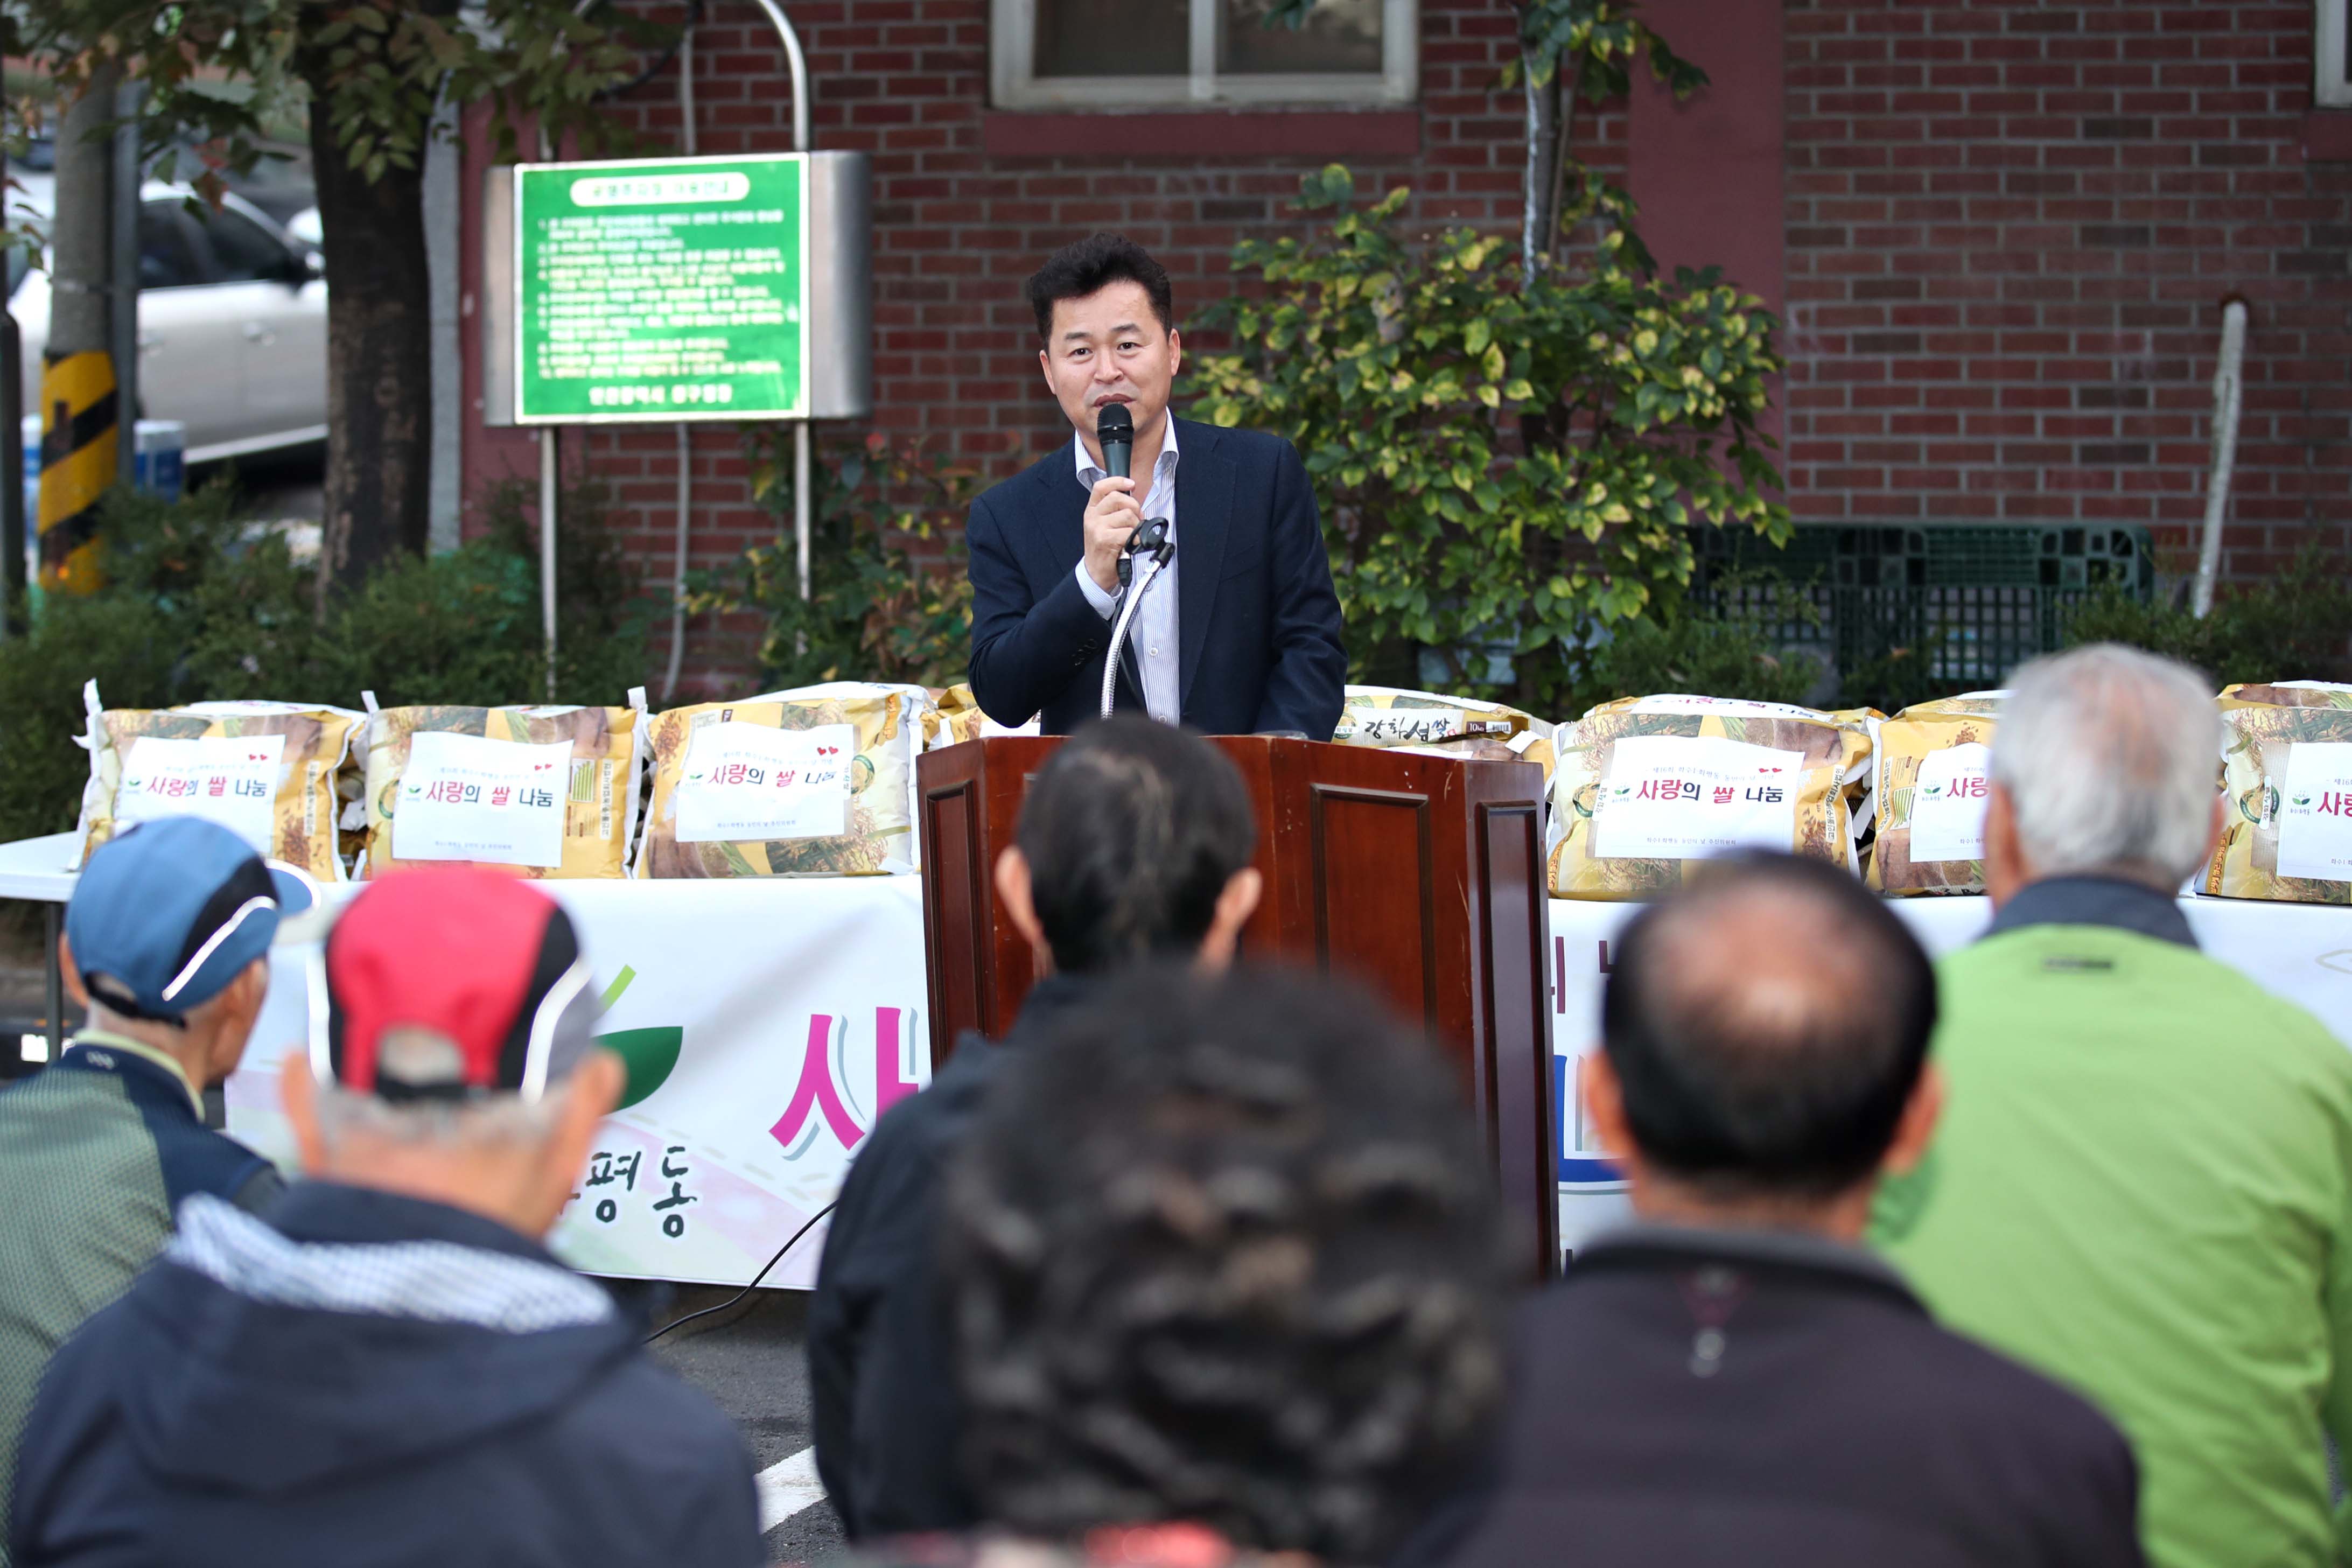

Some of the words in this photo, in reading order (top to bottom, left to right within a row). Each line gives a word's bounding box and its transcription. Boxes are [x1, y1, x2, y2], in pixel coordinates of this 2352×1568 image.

[146, 776, 199, 797] 사랑의
[208, 776, 227, 796] 쌀
[235, 779, 267, 797] 나눔
[708, 764, 765, 785] 사랑의
[776, 770, 796, 787] 쌀
[426, 781, 480, 803] 사랑의
[492, 786, 510, 806] 쌀
[519, 788, 553, 807] 나눔
[1636, 780, 1700, 801] 사랑의
[1713, 786, 1735, 803] 쌀
[1746, 787, 1783, 802] 나눔
[1947, 778, 1989, 798] 사랑
[571, 1145, 698, 1238] 평동
